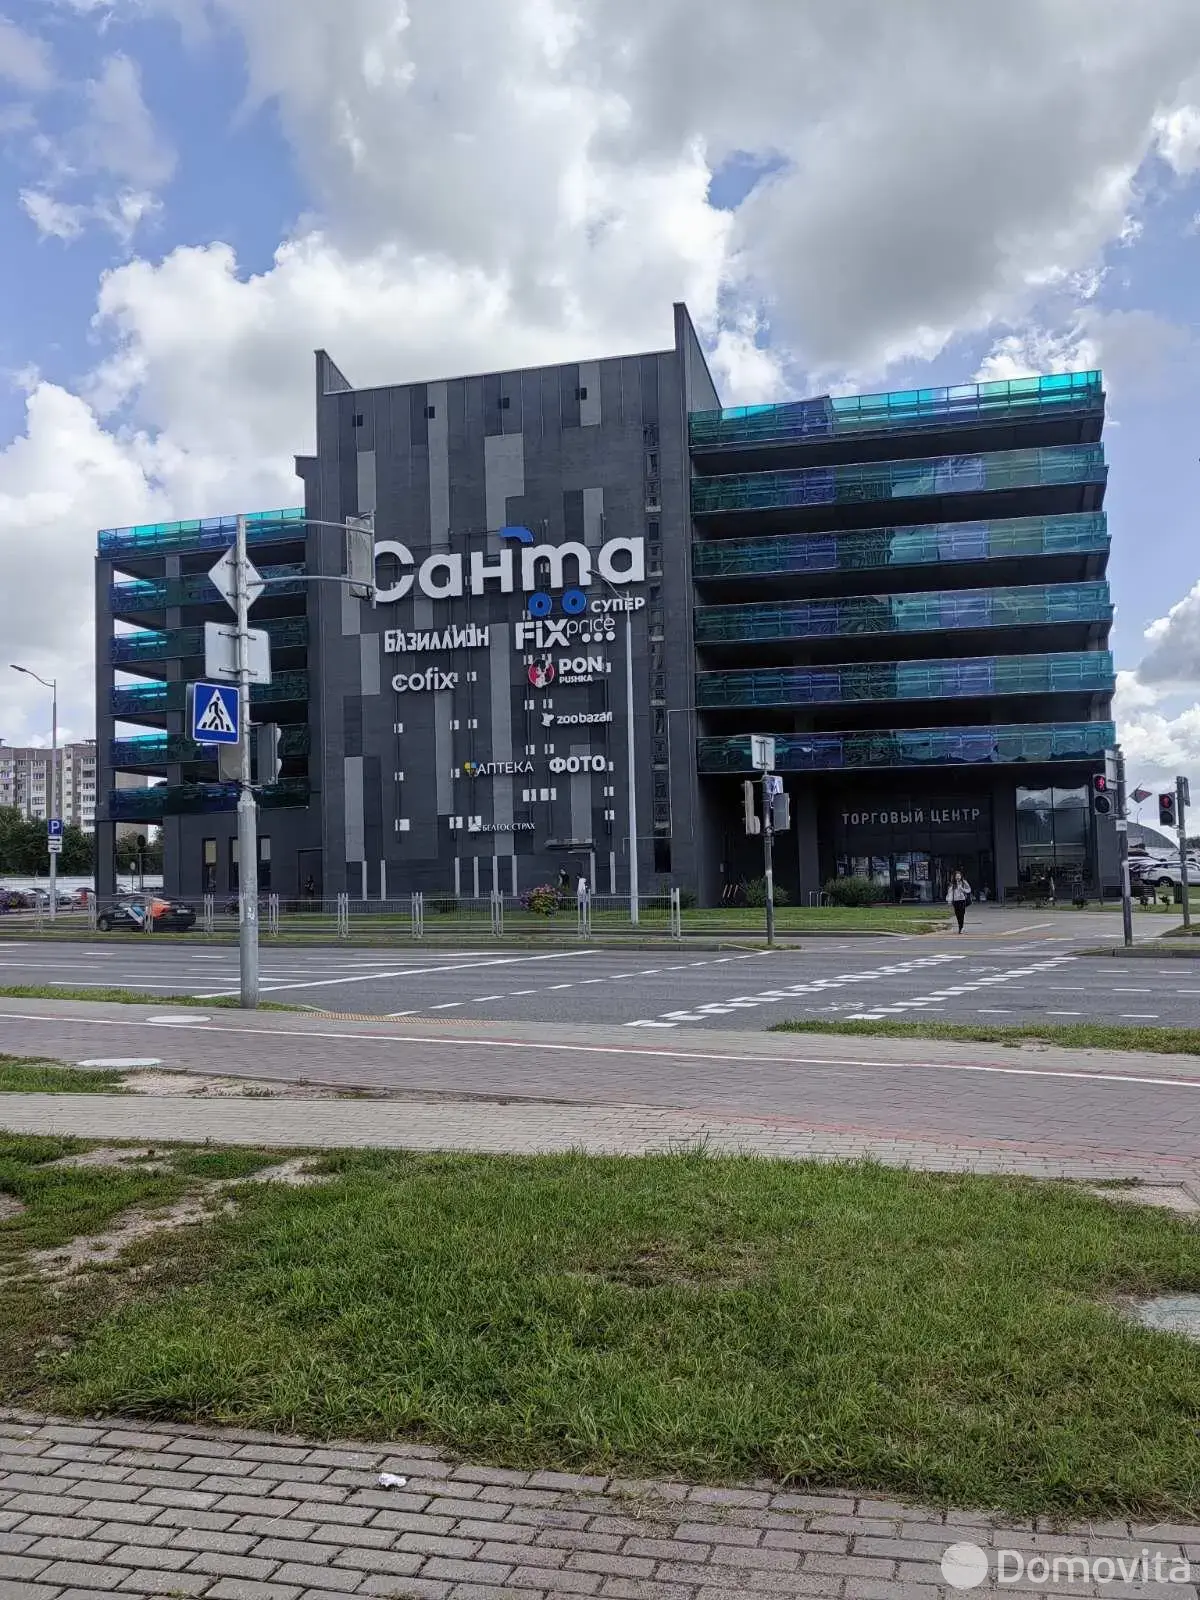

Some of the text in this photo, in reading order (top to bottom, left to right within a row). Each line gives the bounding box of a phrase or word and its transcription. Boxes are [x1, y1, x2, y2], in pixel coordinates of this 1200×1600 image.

[590, 597, 646, 613] СУПЕР
[384, 625, 490, 653] БАЗИЛЛИОН
[391, 666, 456, 692] cofix
[476, 761, 535, 776] АПТЕКА
[549, 755, 606, 773] ФОТО
[841, 807, 980, 825] ТОРГОВЫЙ ЦЕНТР
